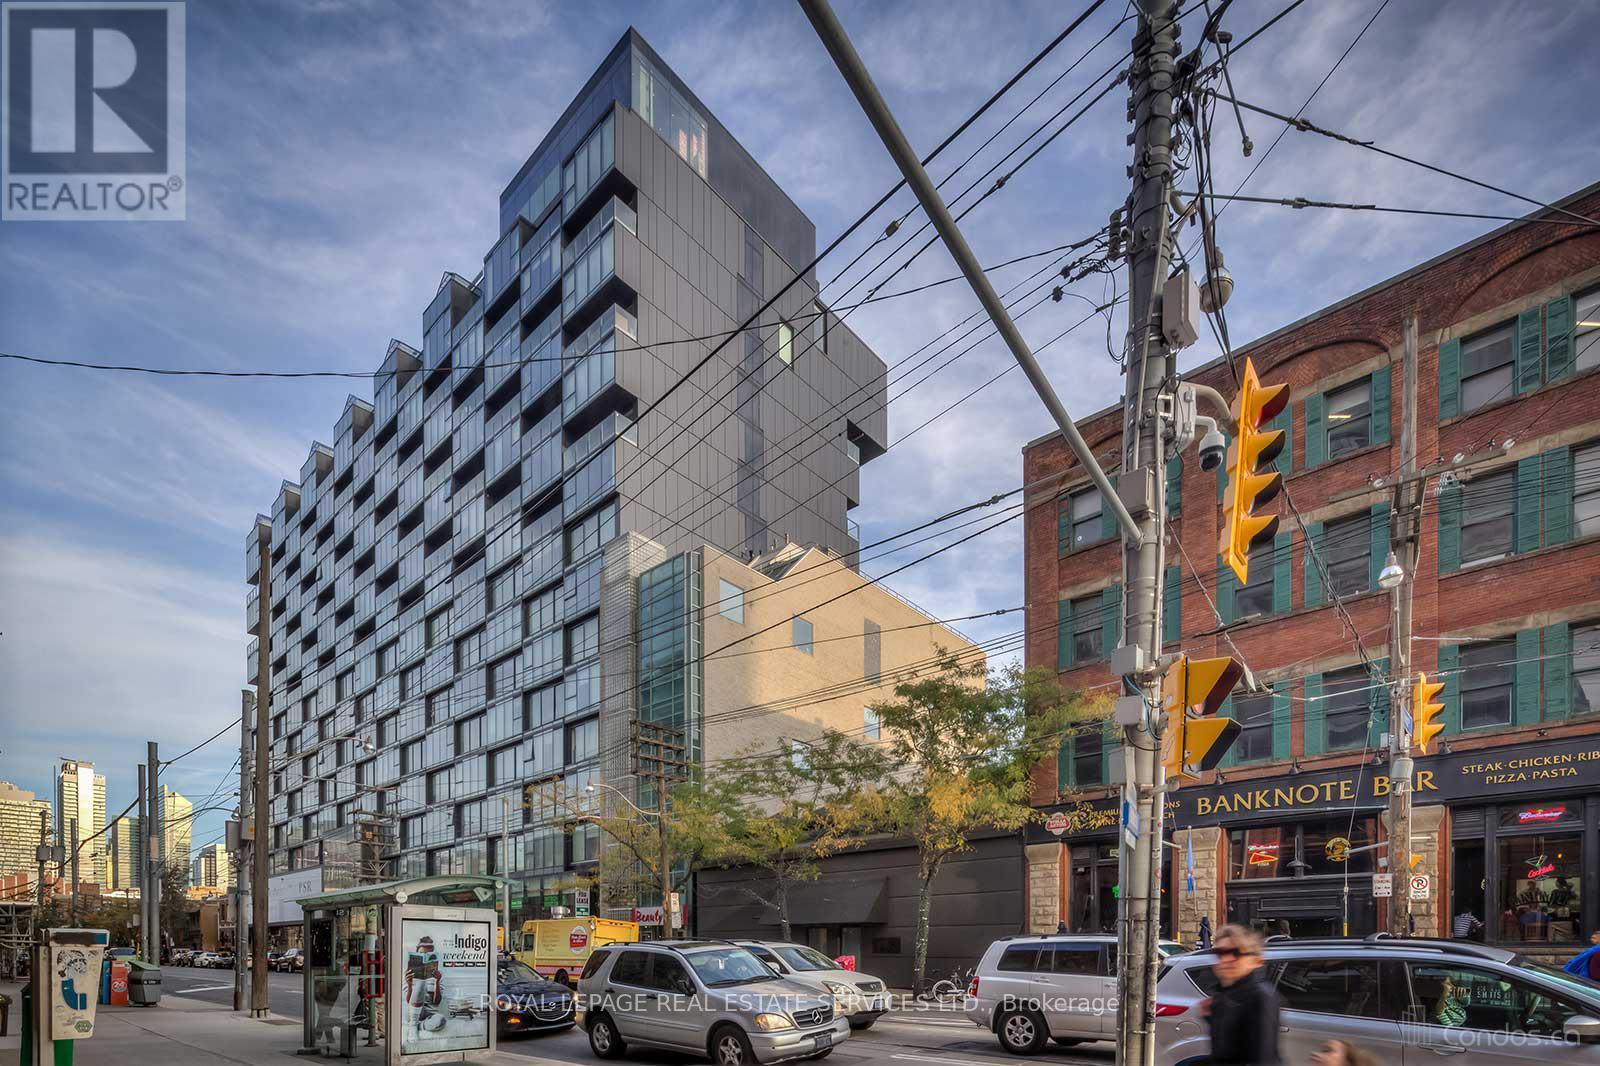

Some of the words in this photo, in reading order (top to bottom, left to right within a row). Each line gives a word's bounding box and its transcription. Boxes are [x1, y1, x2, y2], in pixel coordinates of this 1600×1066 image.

[1196, 779, 1356, 816] BANKNOTE
[1373, 770, 1439, 797] BR
[635, 908, 663, 925] Beauty
[442, 950, 487, 960] weekend
